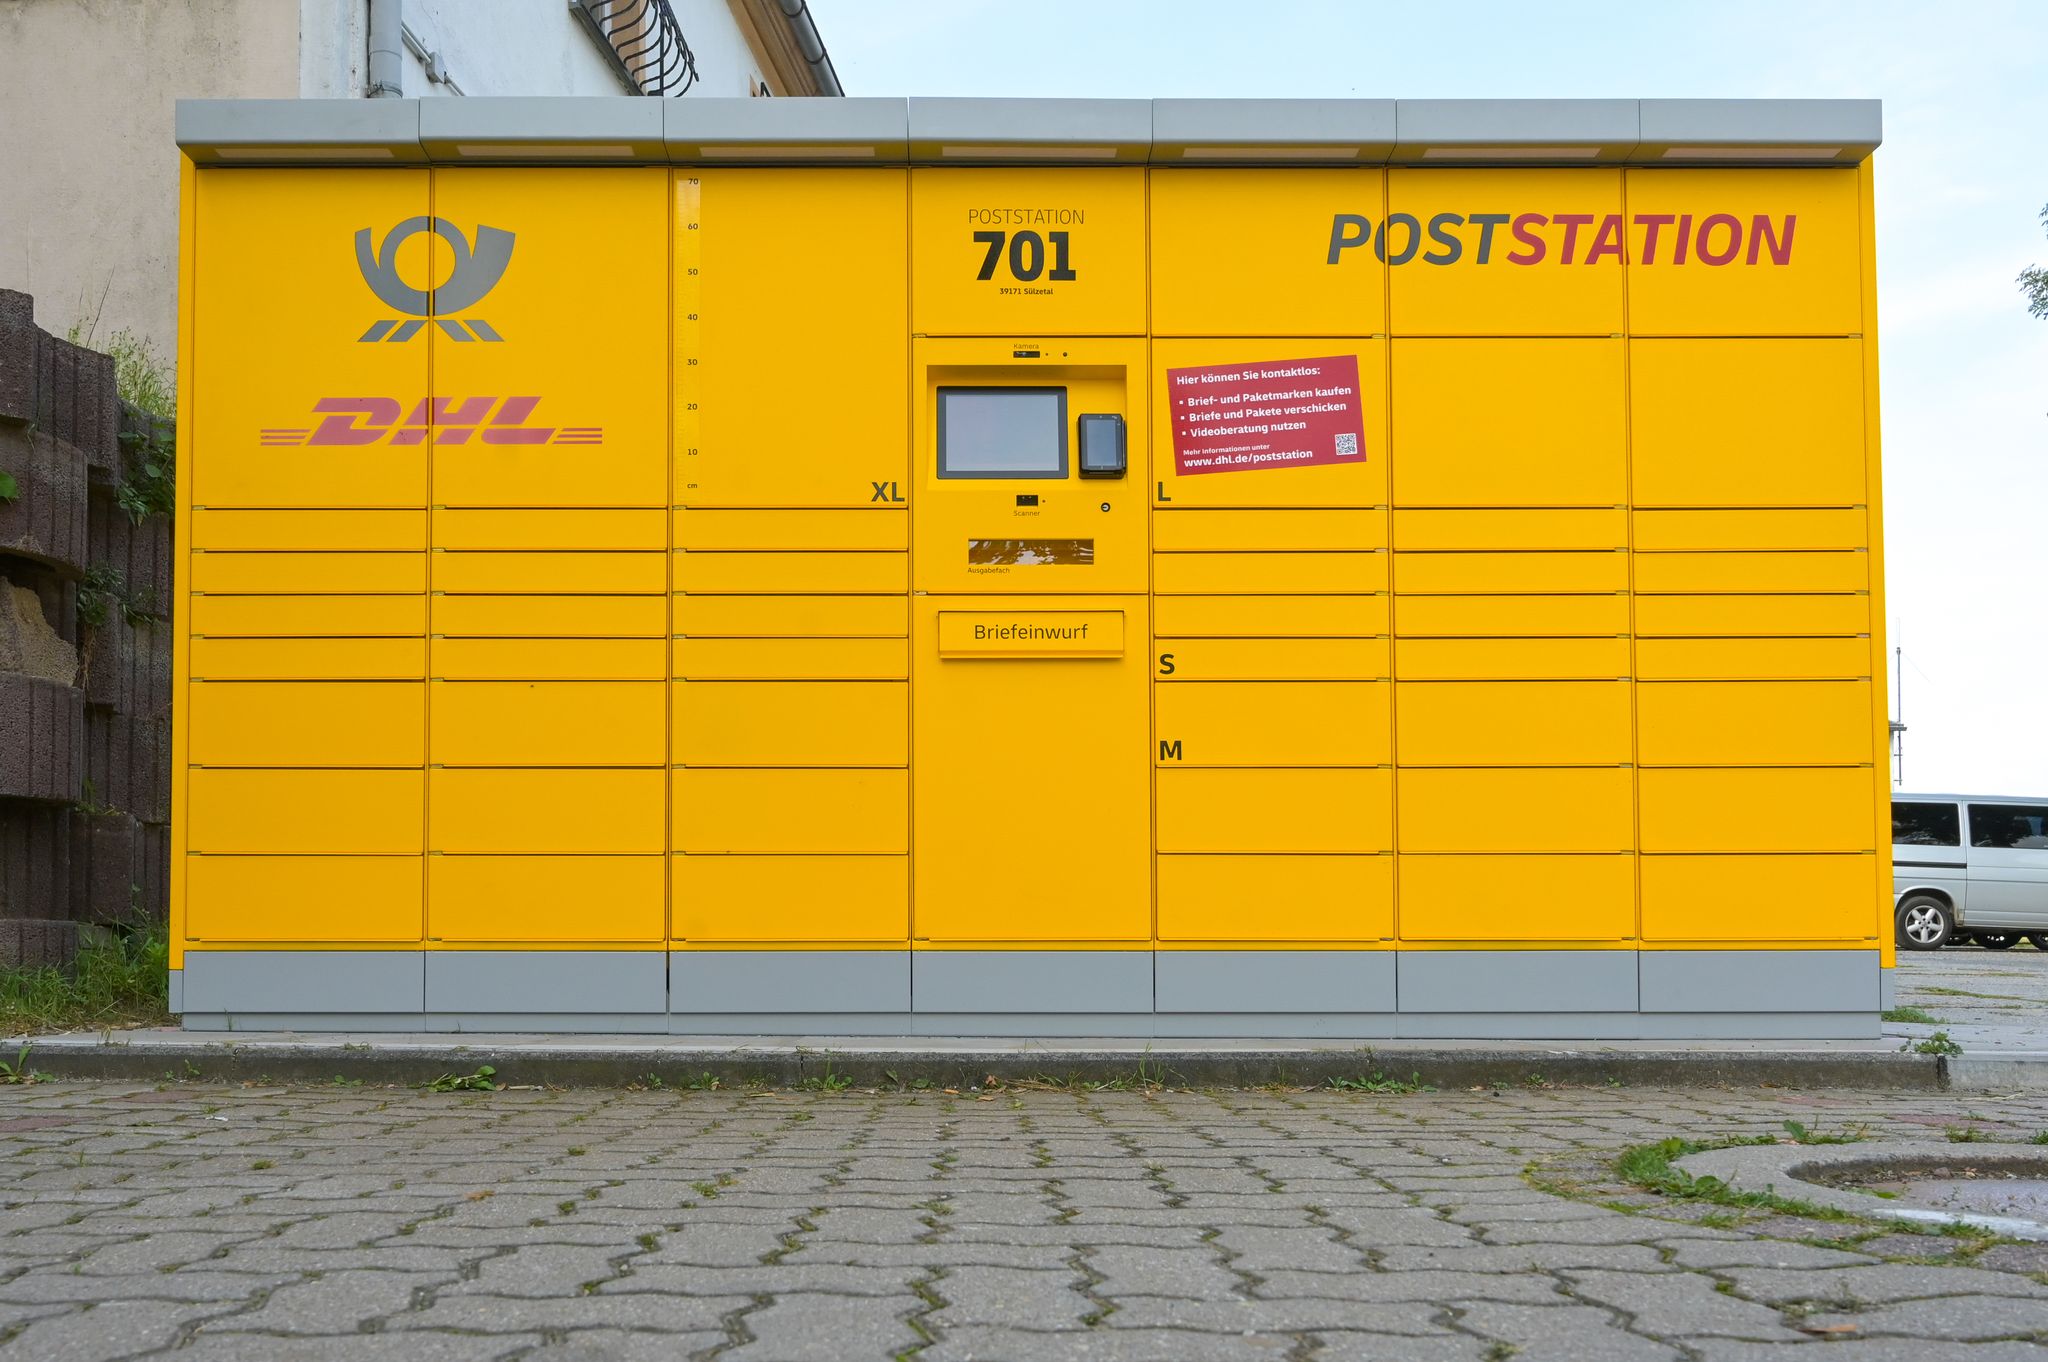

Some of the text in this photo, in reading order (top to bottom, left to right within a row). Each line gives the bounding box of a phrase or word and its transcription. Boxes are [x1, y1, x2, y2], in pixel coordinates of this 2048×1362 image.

[968, 208, 1085, 225] POSTSTATION
[1326, 212, 1797, 267] POSTSTATION
[973, 229, 1077, 282] 701
[687, 268, 699, 276] 50
[999, 287, 1054, 296] 39171 Sülzetal
[687, 313, 698, 321] 40
[687, 358, 698, 366] 30
[1176, 366, 1321, 385] Hier können Sie kontaktlos:
[1187, 386, 1352, 407] Brief- und Paketmarken kaufen
[687, 403, 698, 411] 20
[1189, 402, 1347, 422] Briefe und Pakete verschicken
[306, 396, 557, 446] DHL
[1190, 420, 1307, 438] Videoberatung nutzen
[687, 448, 698, 456] 10
[1183, 443, 1271, 456] Mehr Informationen unter
[1184, 448, 1313, 468] www.dhl.de/poststation
[871, 481, 905, 502] XL
[1157, 481, 1172, 502] L
[967, 566, 1010, 575] Ausgabefach
[974, 623, 1089, 640] Briefeinwurf
[1159, 653, 1175, 675] S
[1159, 740, 1182, 761] M
